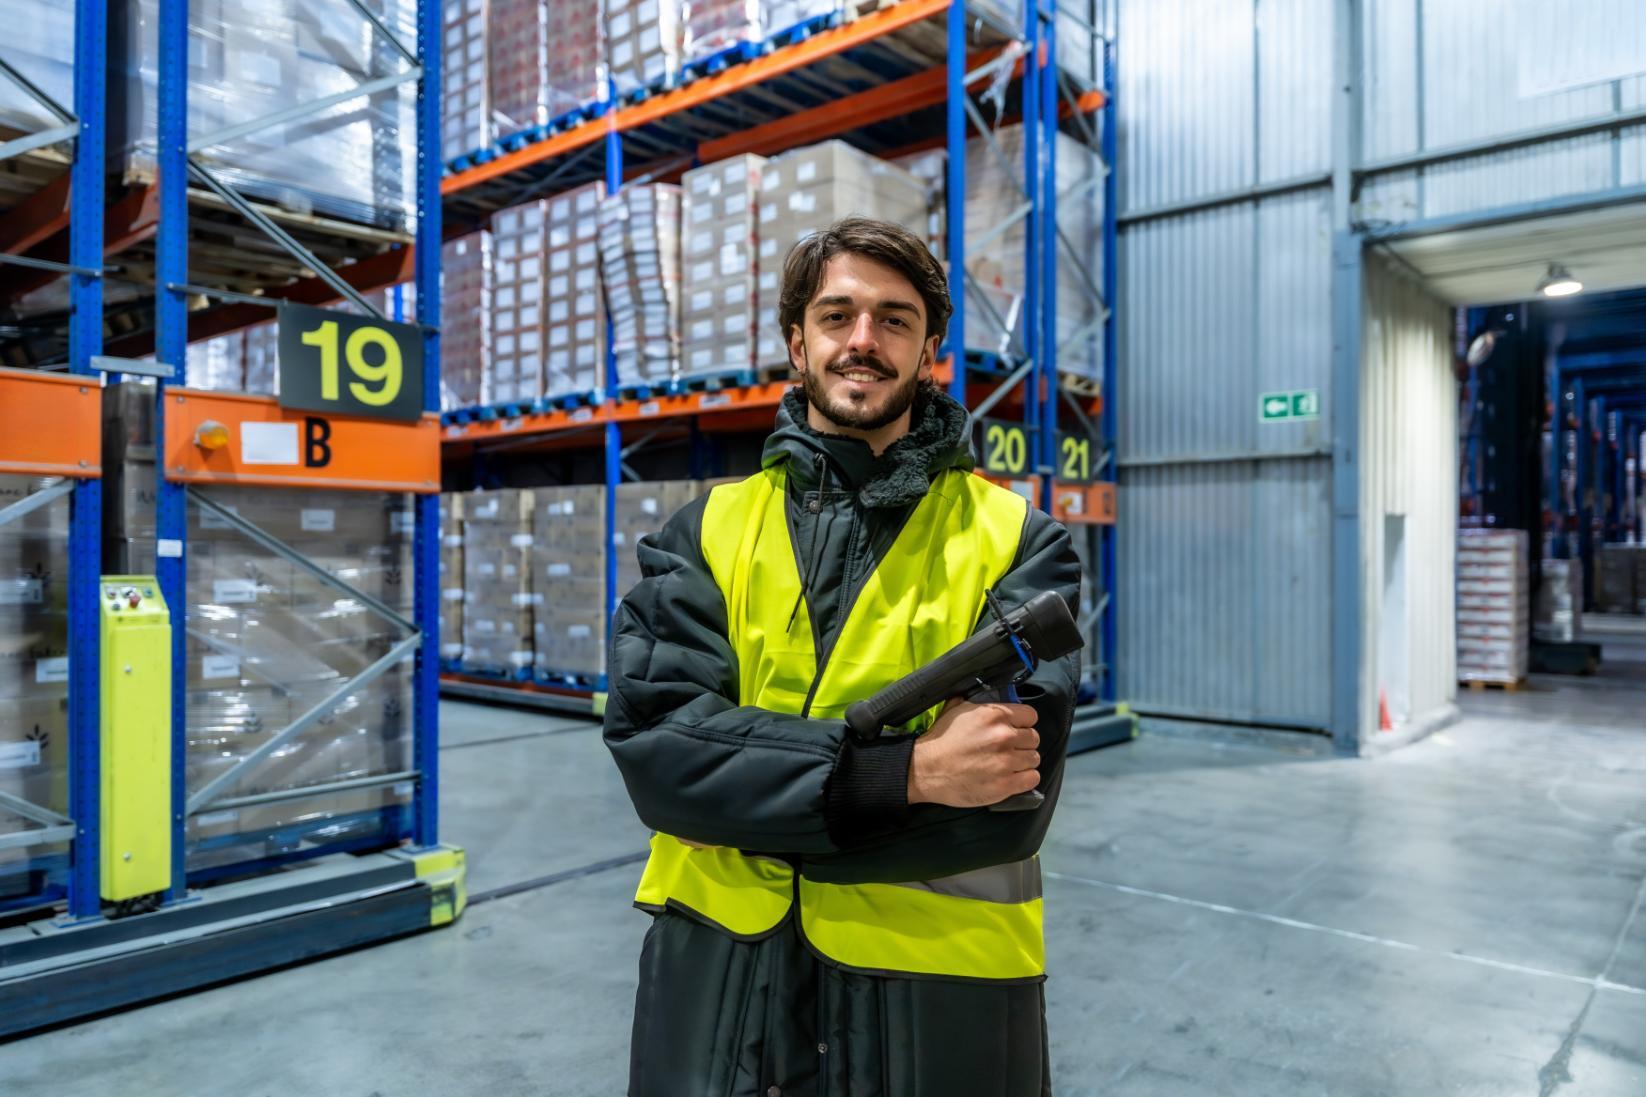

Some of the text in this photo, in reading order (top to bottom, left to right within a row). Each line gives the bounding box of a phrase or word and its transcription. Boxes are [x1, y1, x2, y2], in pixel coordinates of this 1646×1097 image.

[302, 320, 403, 406] 19
[305, 417, 332, 468] B
[987, 425, 1026, 473] 20
[1062, 437, 1089, 480] 21
